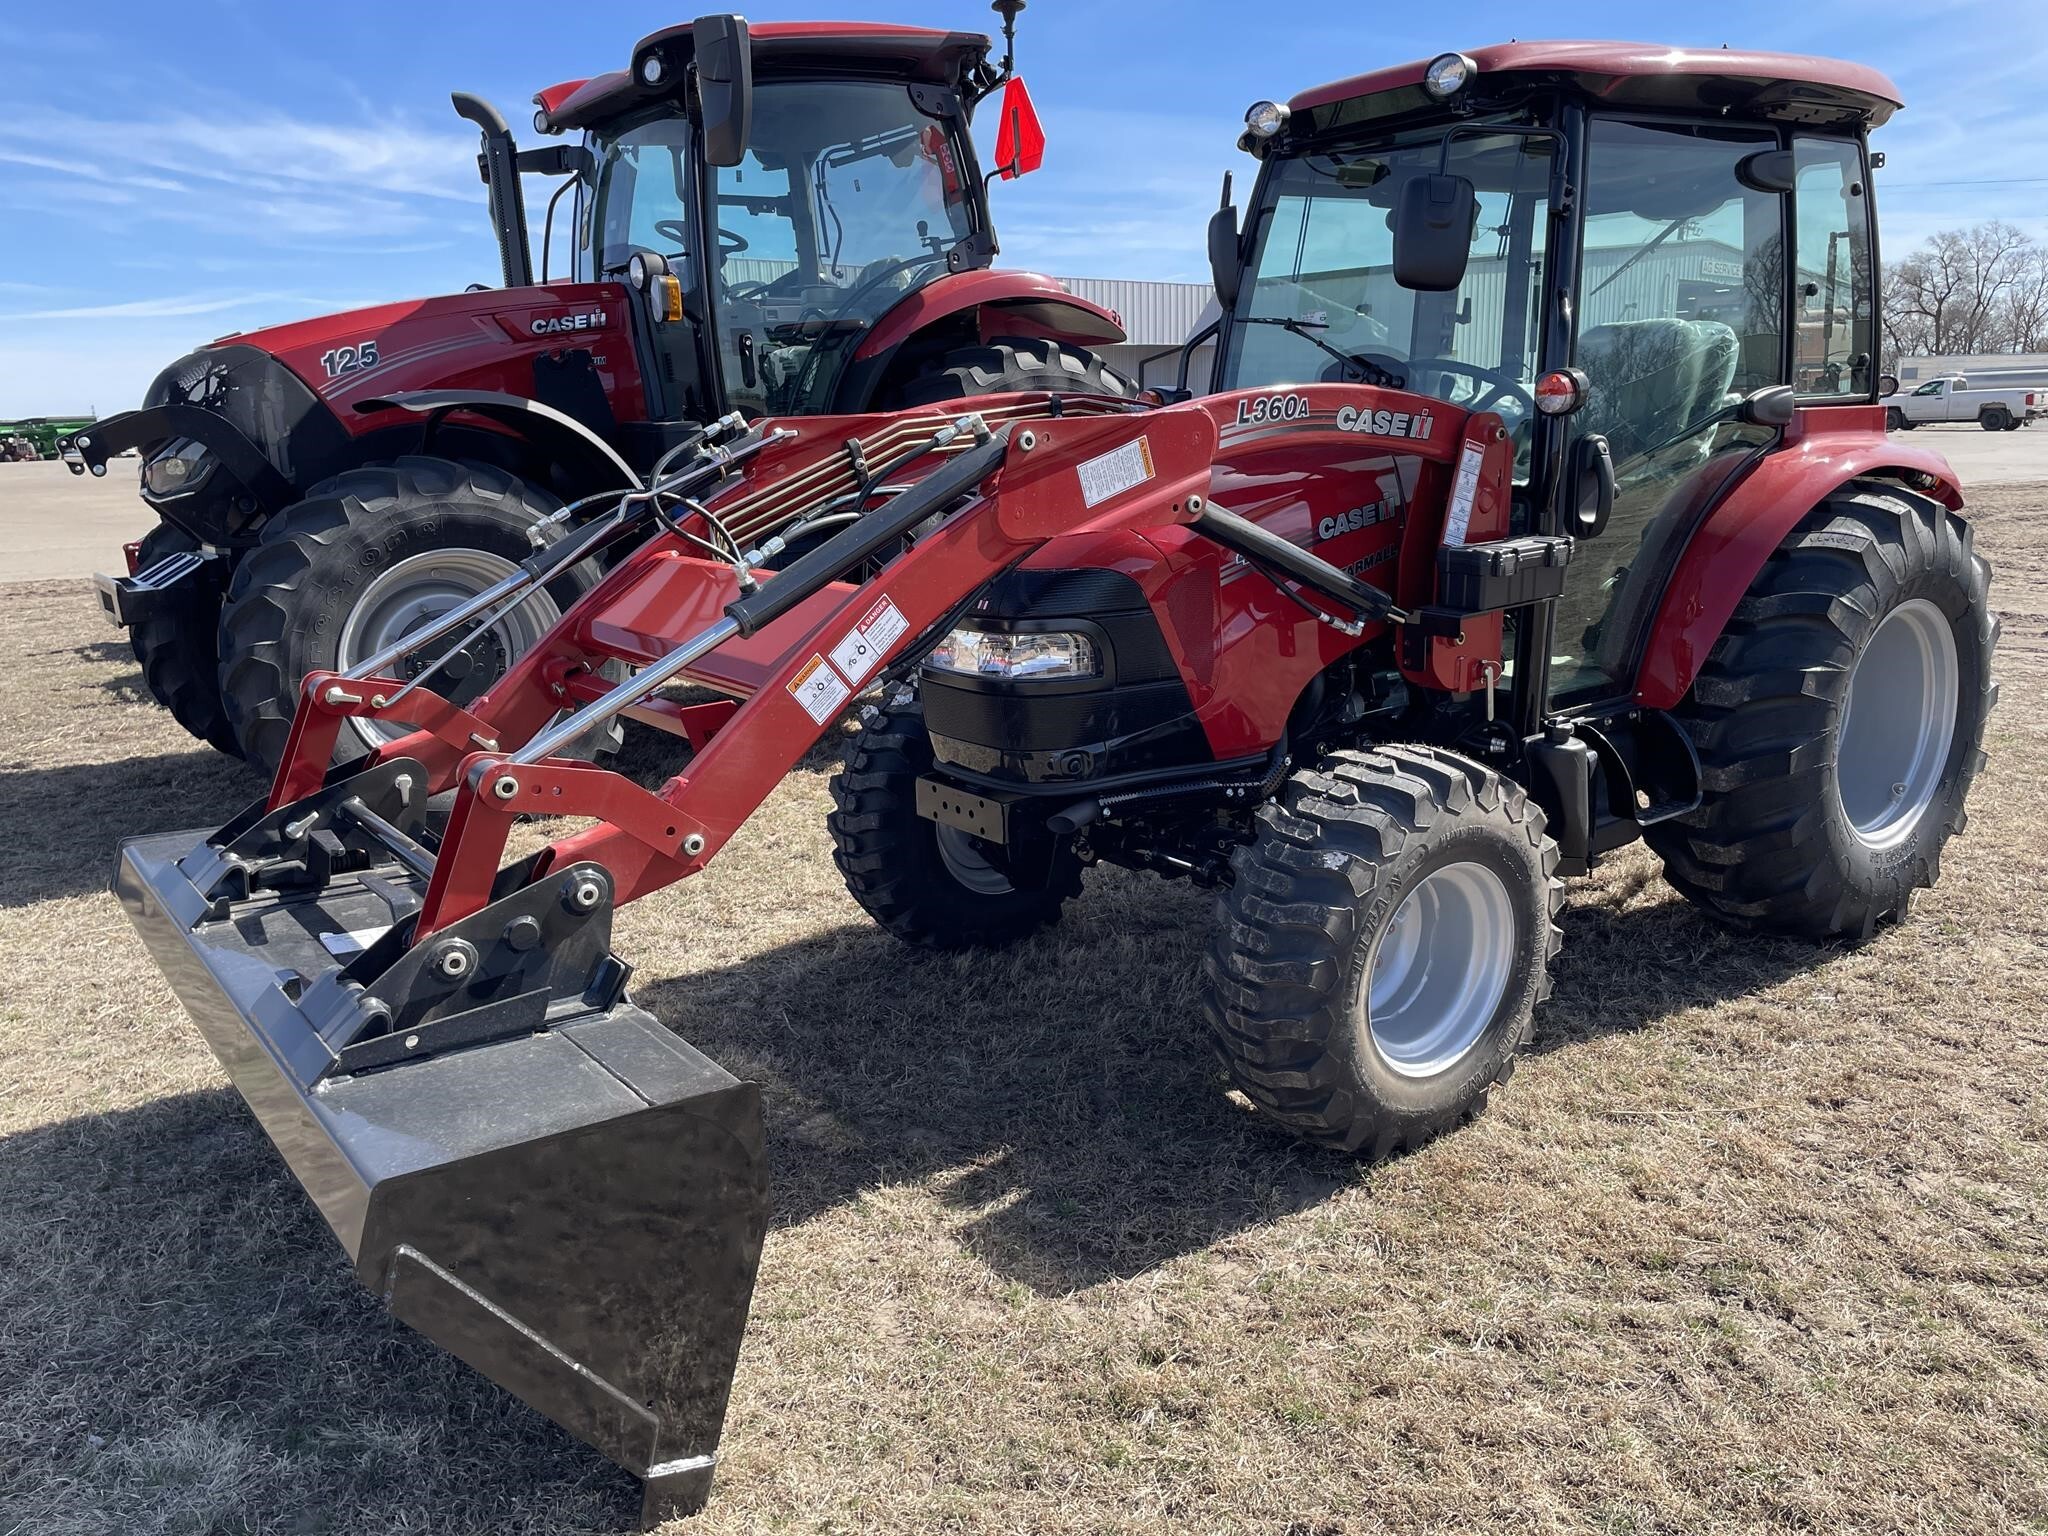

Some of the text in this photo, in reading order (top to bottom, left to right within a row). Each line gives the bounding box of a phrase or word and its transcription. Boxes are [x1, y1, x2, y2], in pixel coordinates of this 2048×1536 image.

[1702, 261, 1713, 273] AG
[531, 318, 588, 335] CASE
[320, 340, 381, 377] 125
[1236, 393, 1310, 427] L360A
[1336, 404, 1409, 437] CASE
[1319, 502, 1377, 540] CASE
[865, 600, 888, 626] DANGER
[799, 660, 819, 684] WARNING
